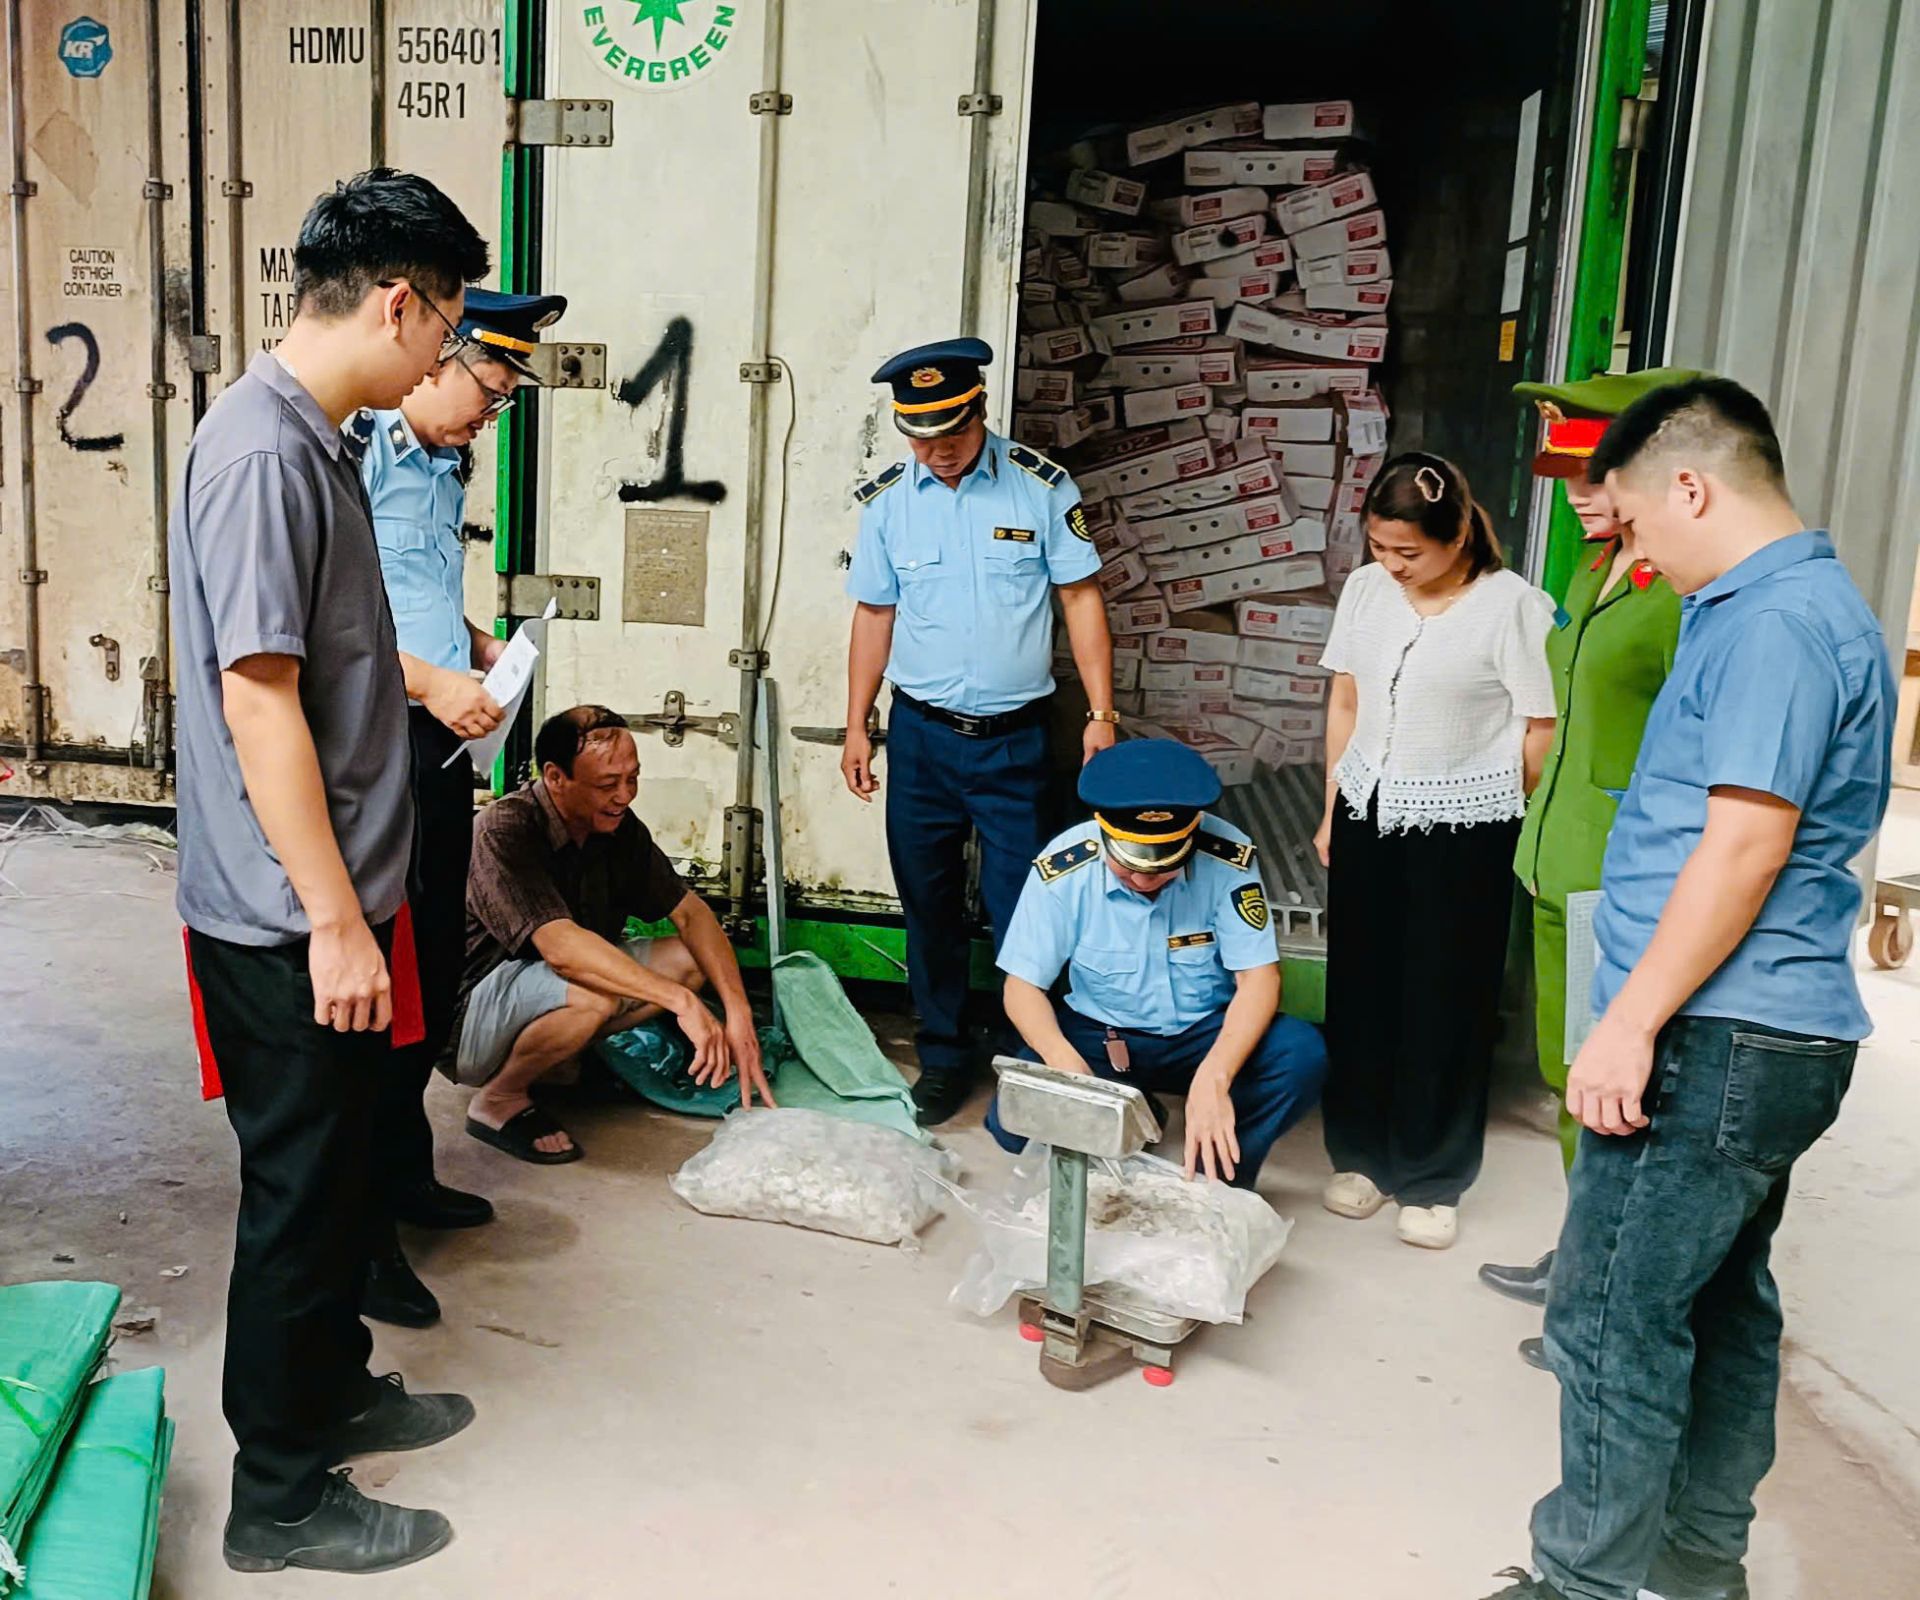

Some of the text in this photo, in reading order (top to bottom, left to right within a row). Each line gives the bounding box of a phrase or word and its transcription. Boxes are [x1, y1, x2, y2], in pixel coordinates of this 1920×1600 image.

[289, 27, 501, 66] HDMU 556401
[583, 5, 736, 82] EVERGREEN
[397, 82, 466, 118] 45R1
[69, 248, 115, 264] CAUTION
[63, 281, 122, 298] CONTAINER
[46, 322, 125, 452] 2
[610, 315, 728, 506] 1
